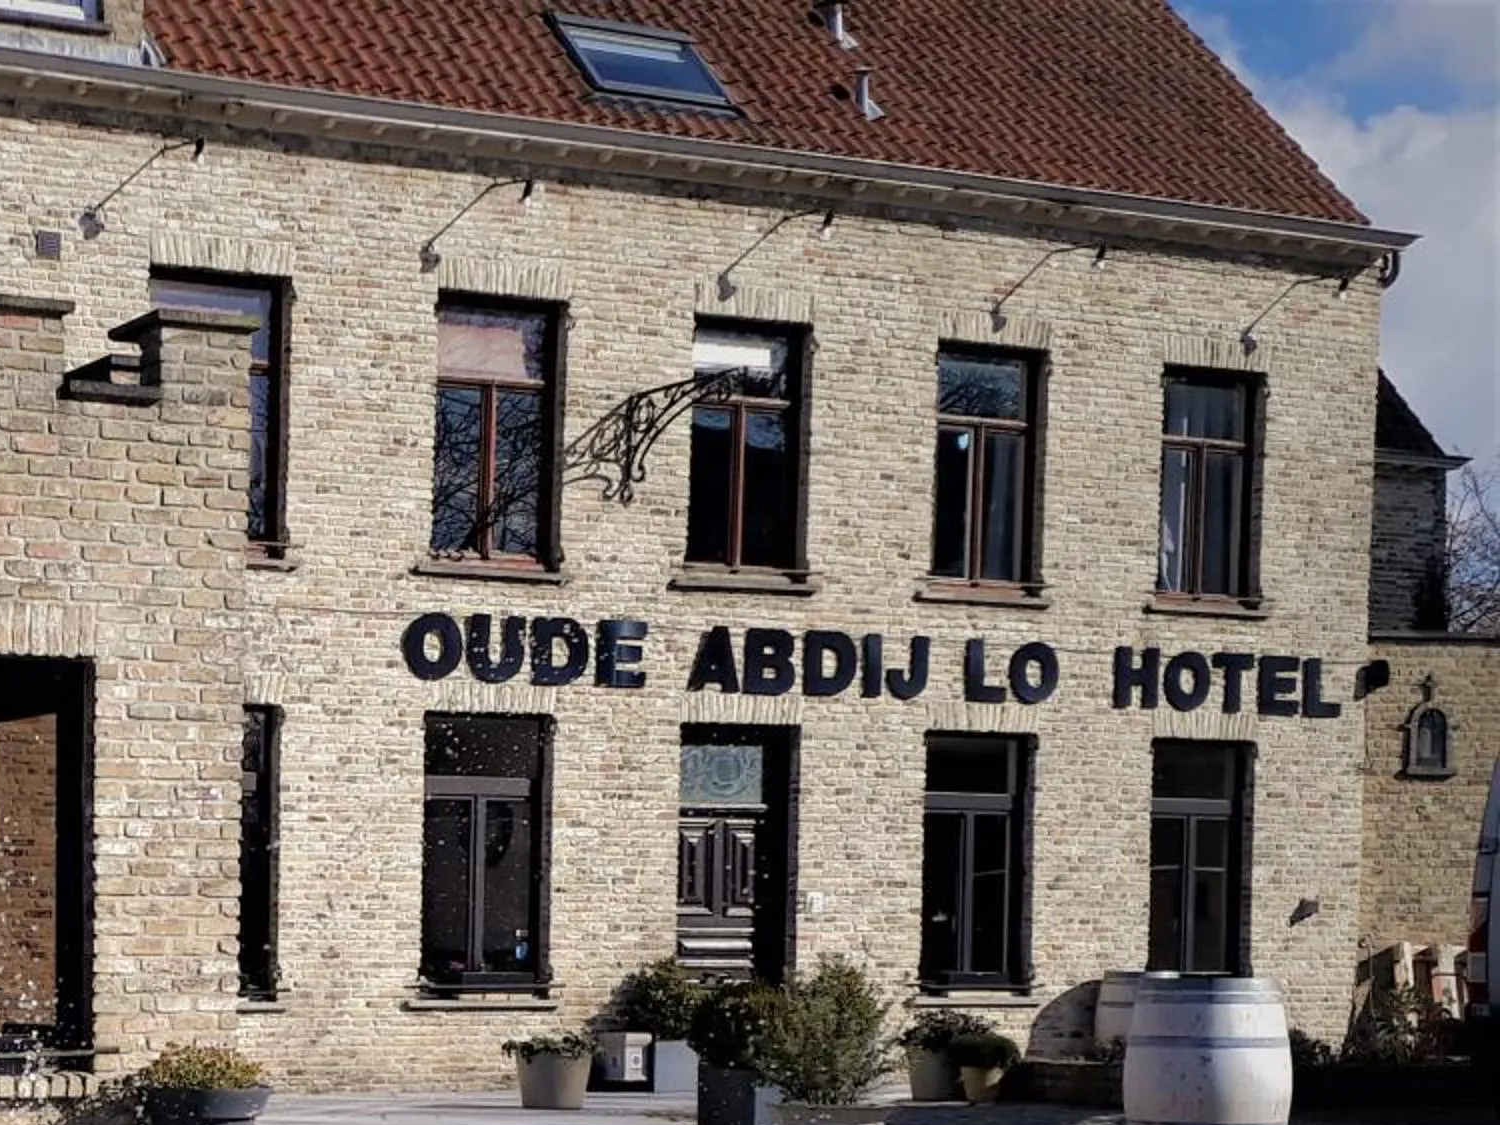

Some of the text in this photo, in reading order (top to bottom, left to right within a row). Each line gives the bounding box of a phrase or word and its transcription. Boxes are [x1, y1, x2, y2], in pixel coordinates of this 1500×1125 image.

[400, 612, 1341, 718] OUDE ABDIJ LO HOTEL
